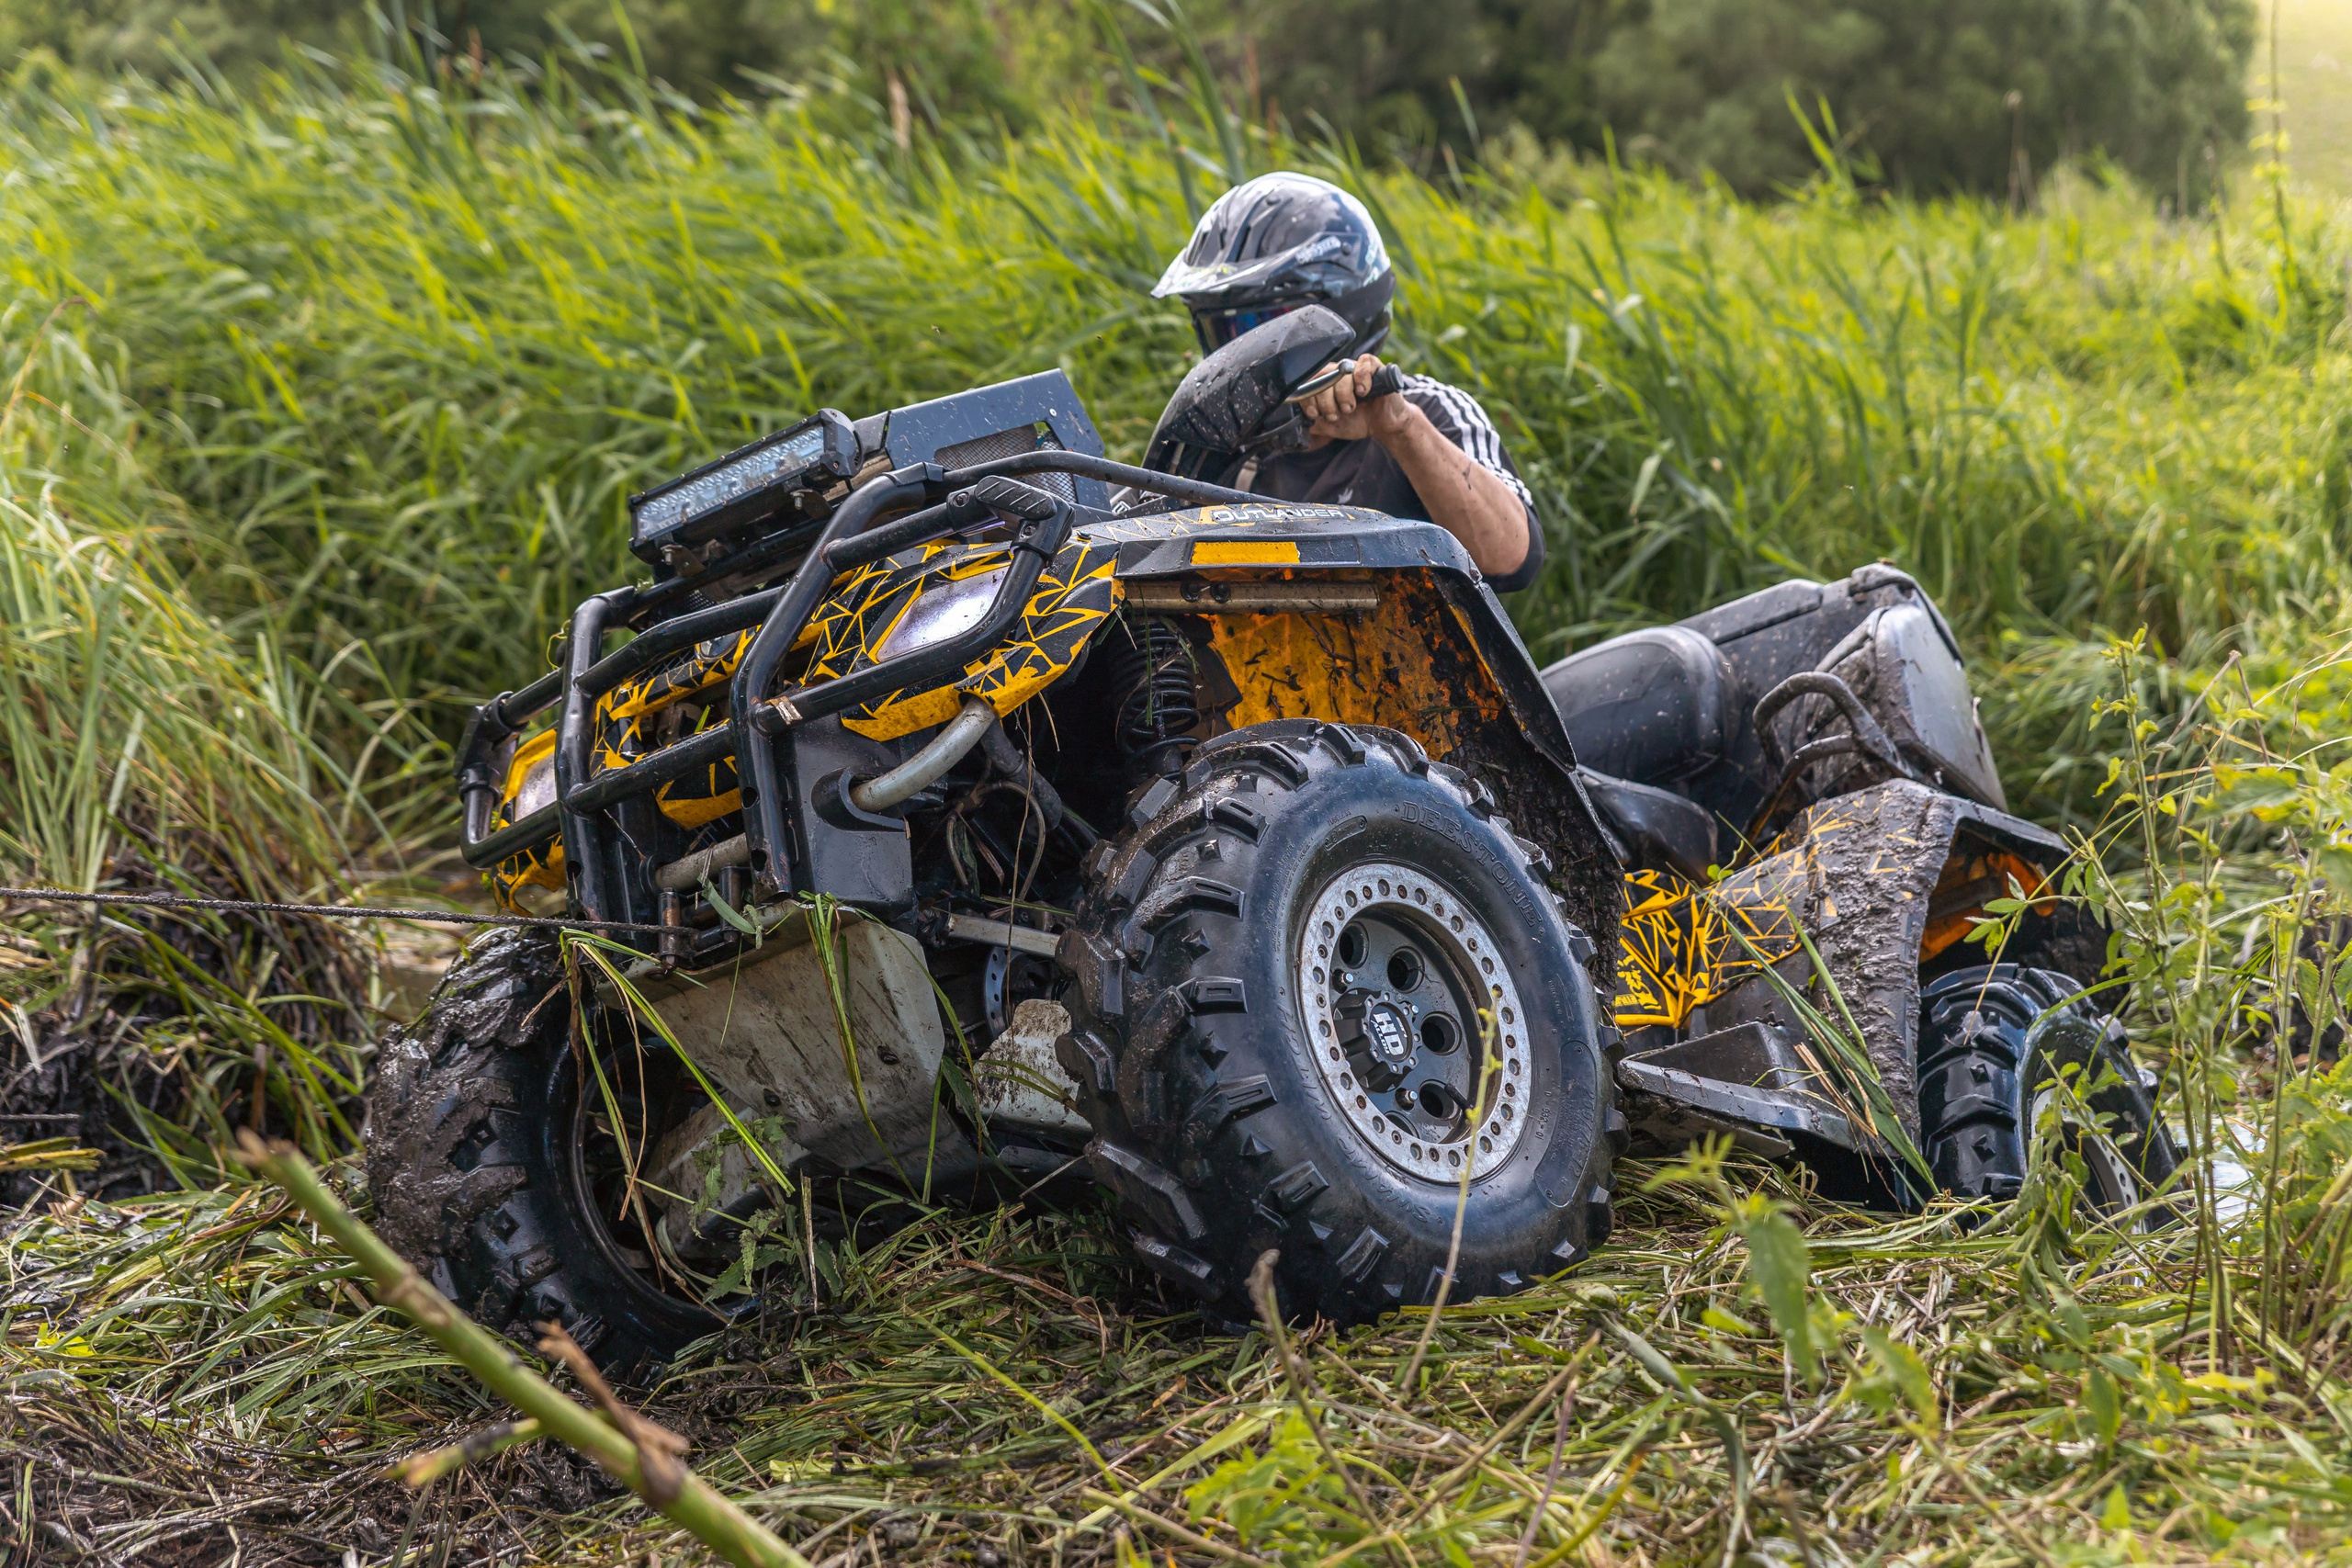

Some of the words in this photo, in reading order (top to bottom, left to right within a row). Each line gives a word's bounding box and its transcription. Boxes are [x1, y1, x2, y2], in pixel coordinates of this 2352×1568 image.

[1210, 508, 1345, 522] OUTLANDER
[1401, 800, 1543, 928] DEESTONE
[1373, 1011, 1404, 1055] HD
